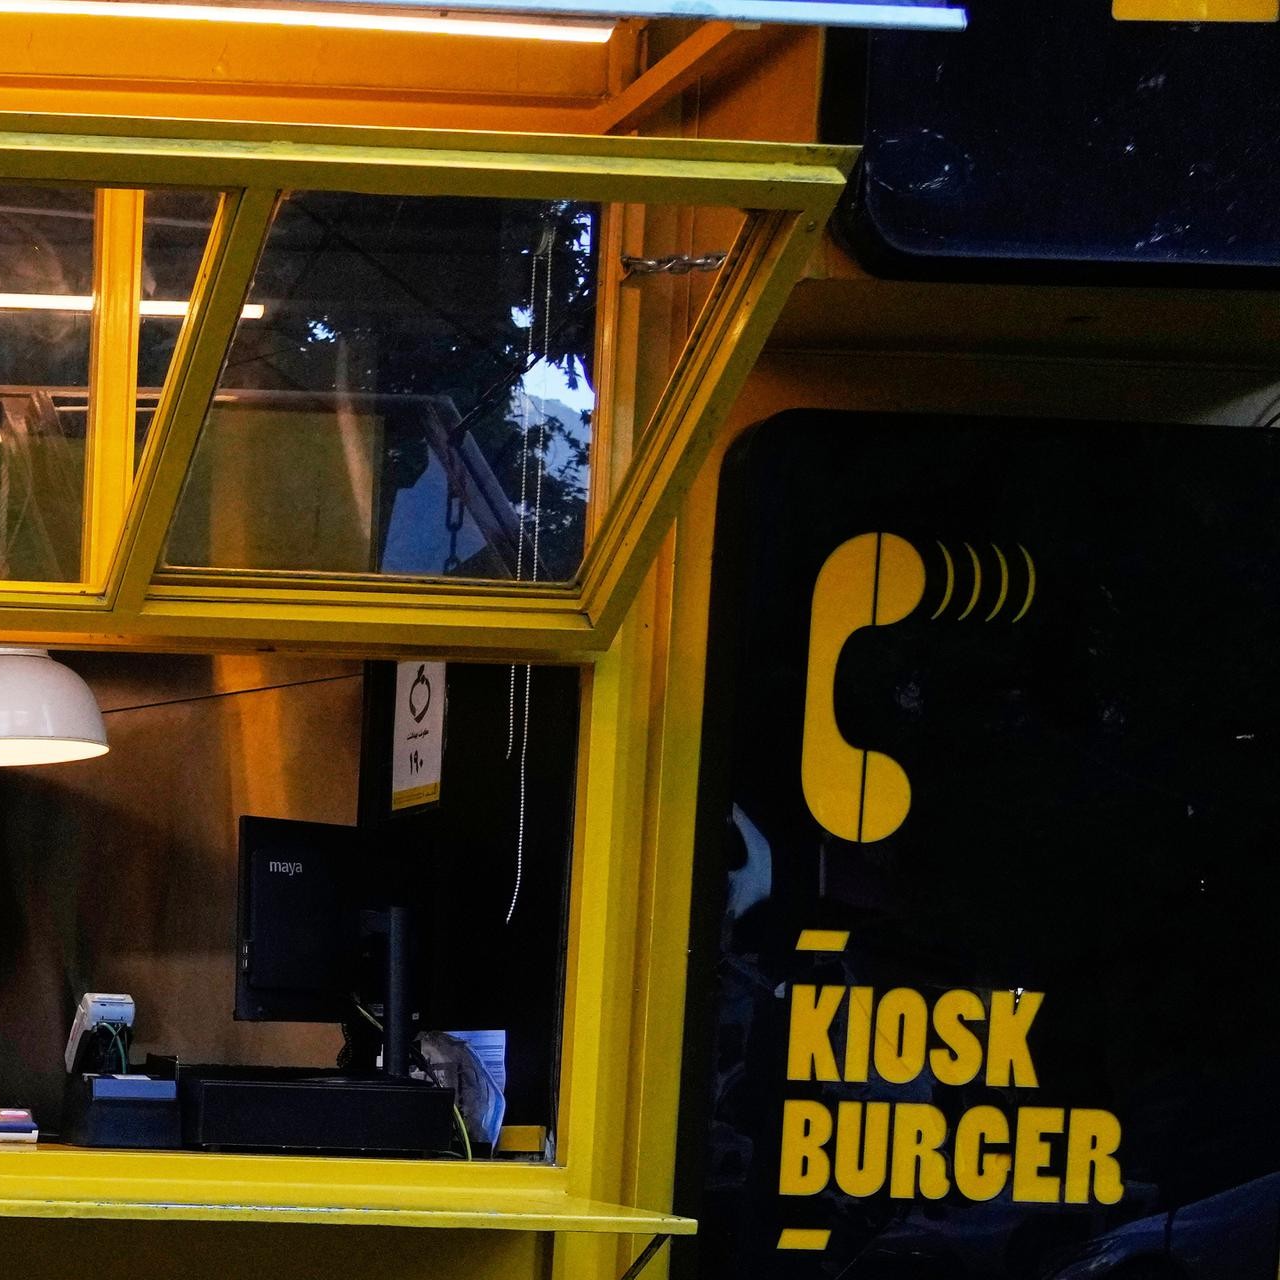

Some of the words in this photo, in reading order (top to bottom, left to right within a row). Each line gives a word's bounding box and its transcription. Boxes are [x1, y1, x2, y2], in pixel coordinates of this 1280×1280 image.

[269, 861, 303, 876] maya
[786, 984, 1045, 1088] KIOSK
[778, 1099, 1124, 1205] BURGER
